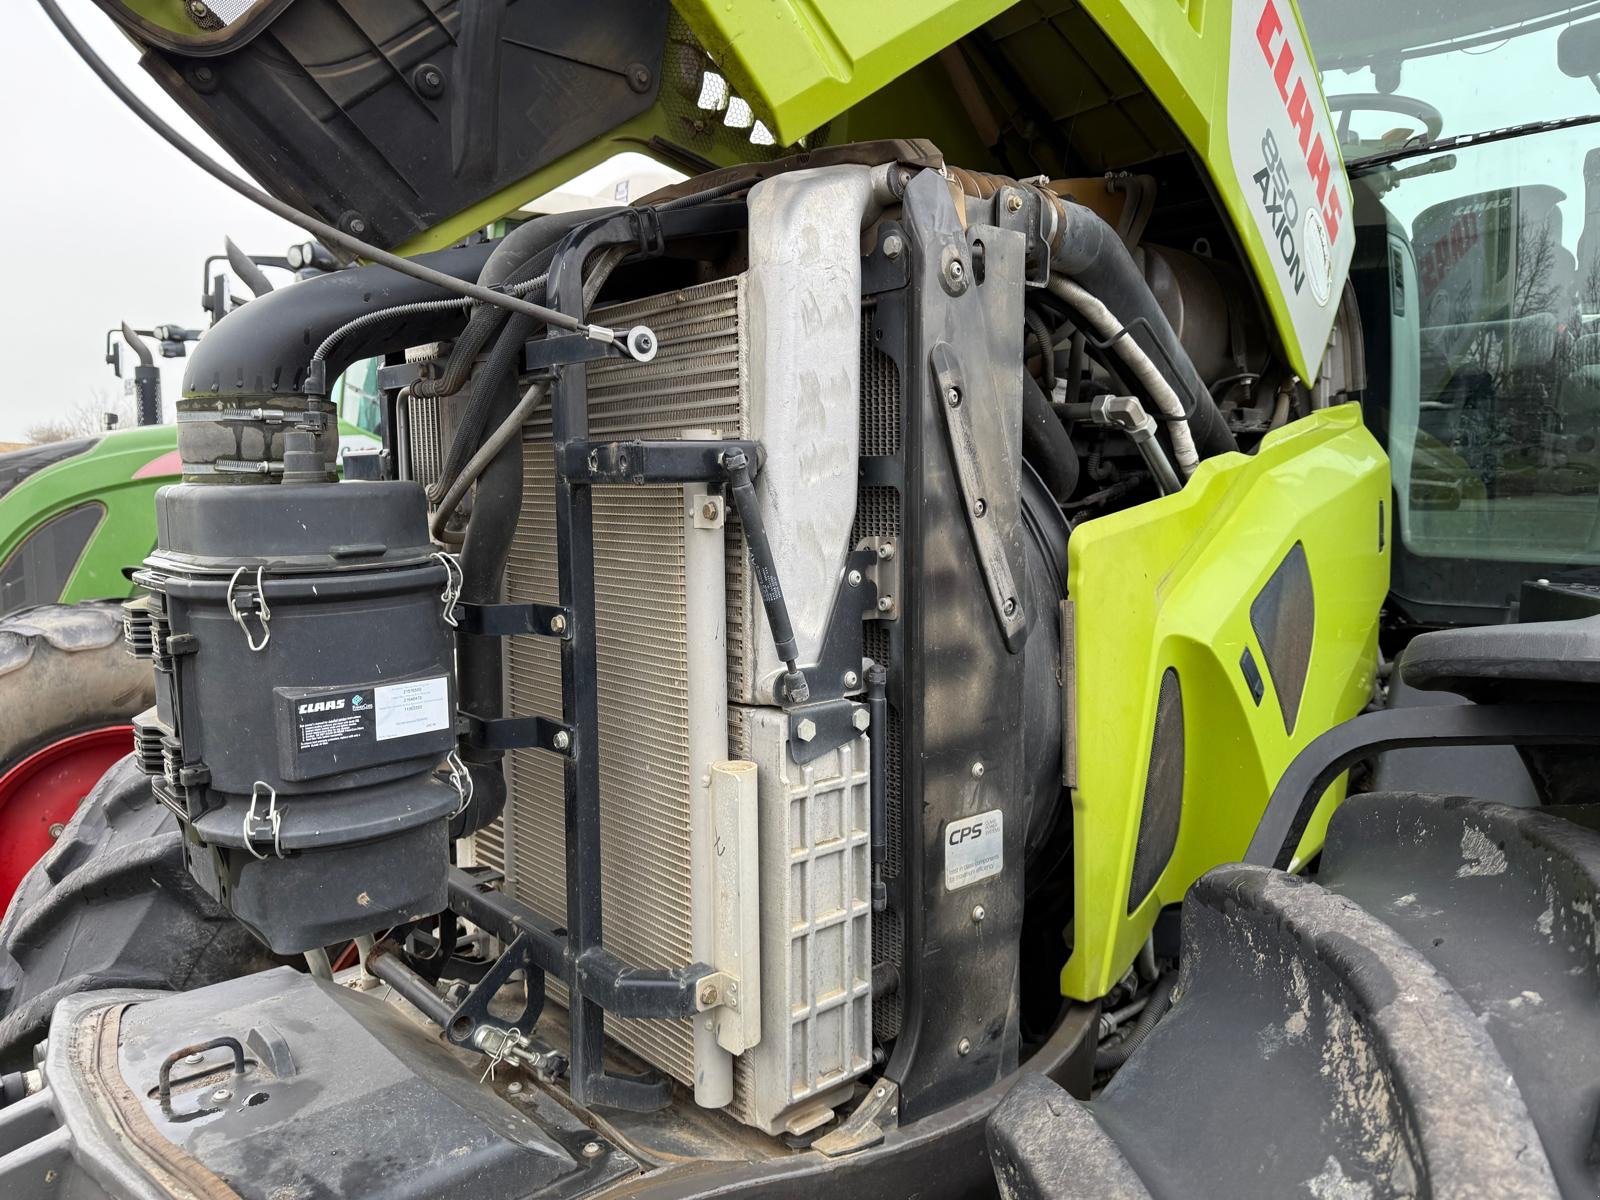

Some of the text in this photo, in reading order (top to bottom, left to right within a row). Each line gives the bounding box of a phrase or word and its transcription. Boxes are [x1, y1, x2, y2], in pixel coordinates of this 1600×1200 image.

[1256, 0, 1343, 247] CLAAS
[1262, 128, 1299, 230] 850
[1253, 166, 1305, 296] AXION
[298, 699, 345, 714] CLAAS
[949, 823, 983, 846] CPS
